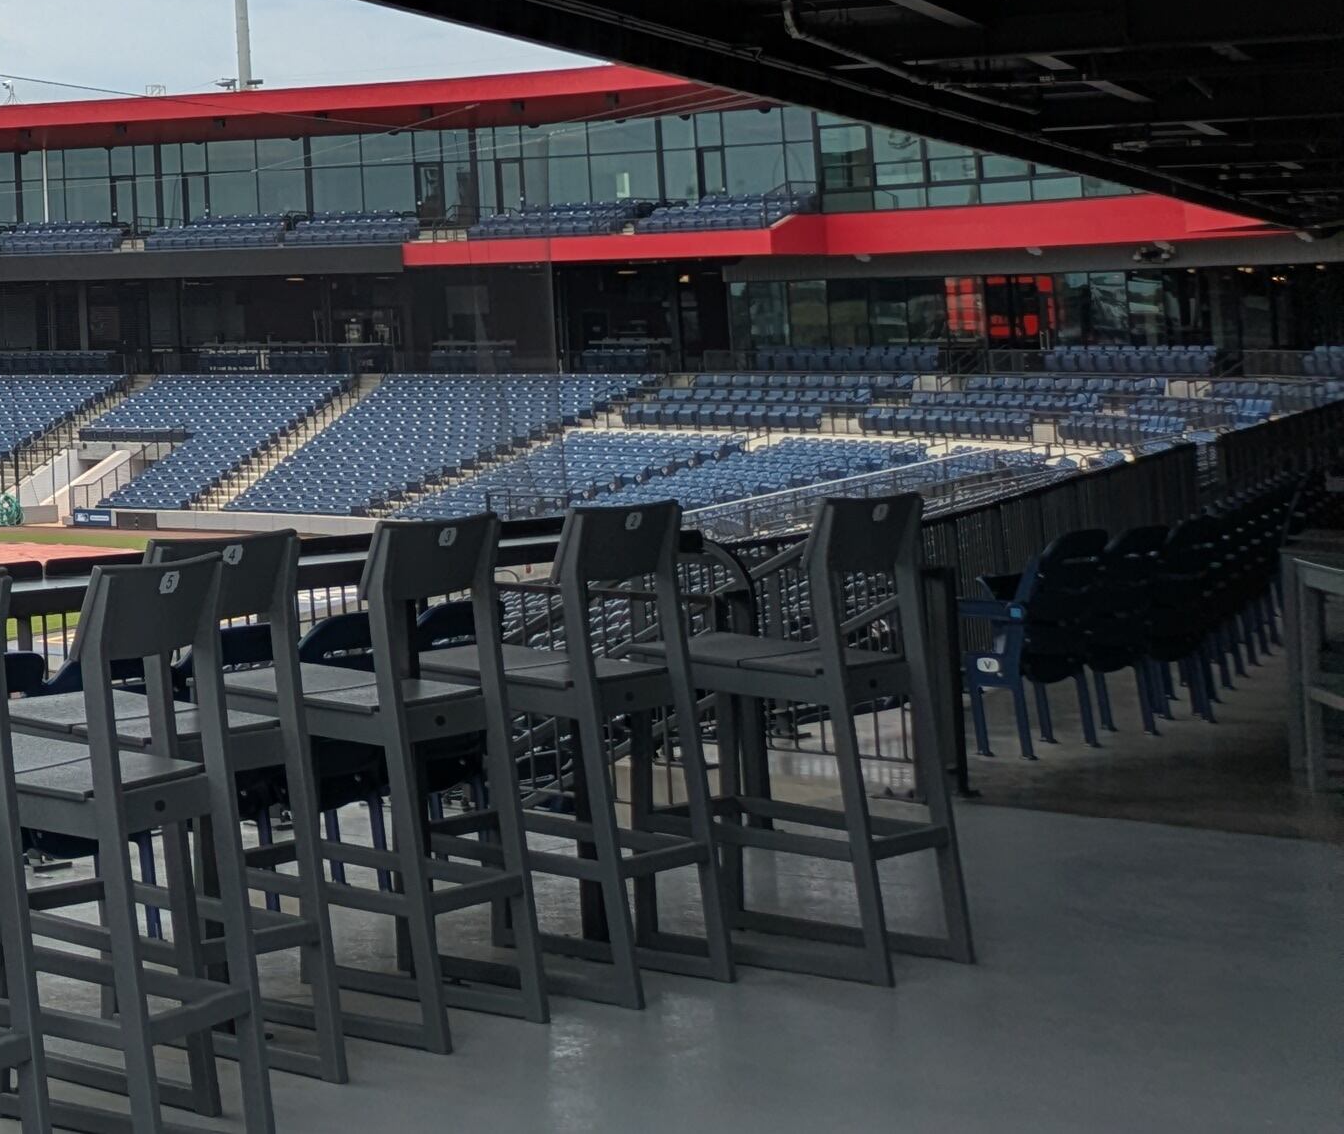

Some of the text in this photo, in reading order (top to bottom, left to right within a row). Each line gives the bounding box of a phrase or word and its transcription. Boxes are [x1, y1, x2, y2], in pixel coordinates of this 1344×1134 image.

[630, 515, 637, 527] 2
[444, 530, 451, 543] 3
[229, 549, 236, 562] 4
[166, 574, 174, 589] 5
